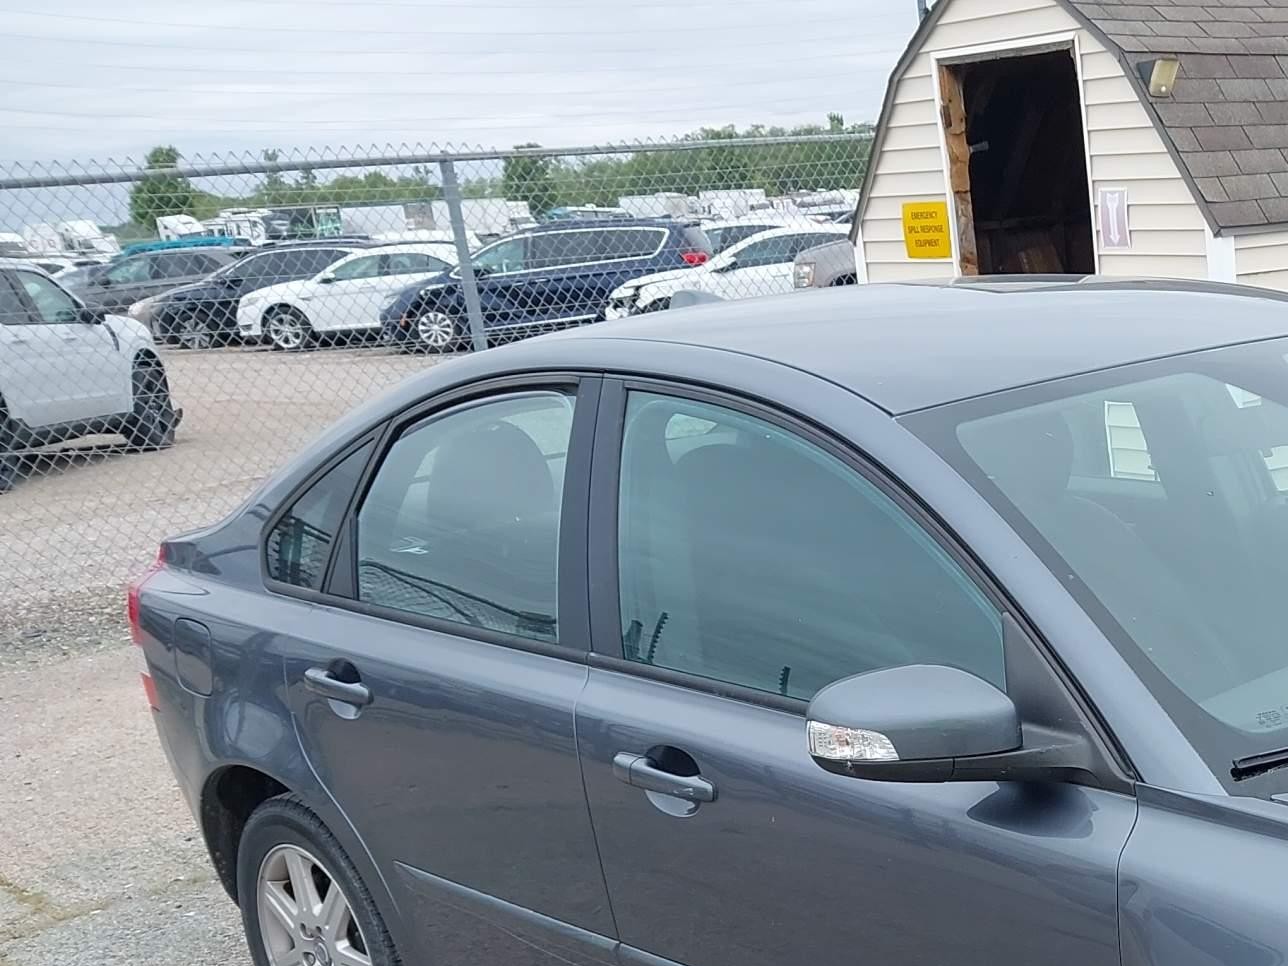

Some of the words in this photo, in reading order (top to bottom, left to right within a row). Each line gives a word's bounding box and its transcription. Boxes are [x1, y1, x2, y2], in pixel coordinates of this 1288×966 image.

[910, 211, 938, 220] EMERGENCY
[907, 225, 919, 234] SPILL
[920, 224, 944, 233] RESPONSE
[915, 238, 941, 248] EQUIPMENT
